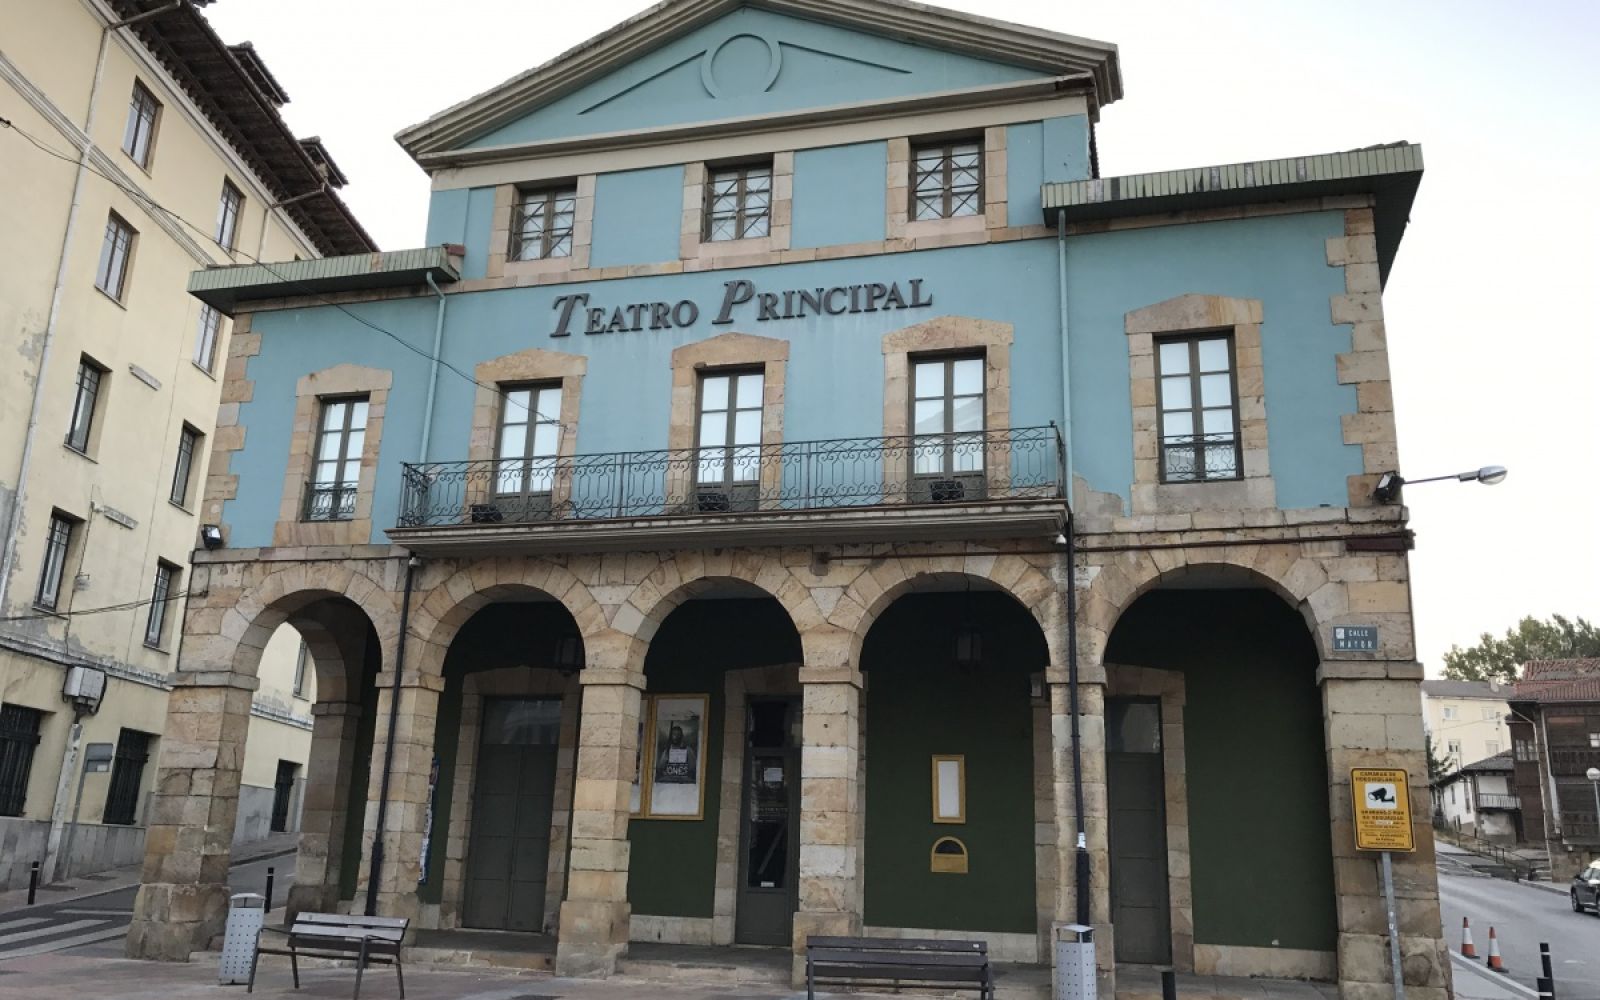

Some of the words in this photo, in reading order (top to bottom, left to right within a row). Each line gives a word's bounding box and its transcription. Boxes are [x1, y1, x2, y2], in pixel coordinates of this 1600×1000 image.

[549, 292, 699, 338] TEATRO
[711, 278, 933, 325] PRINCIPAL
[1348, 629, 1369, 637] CALLE
